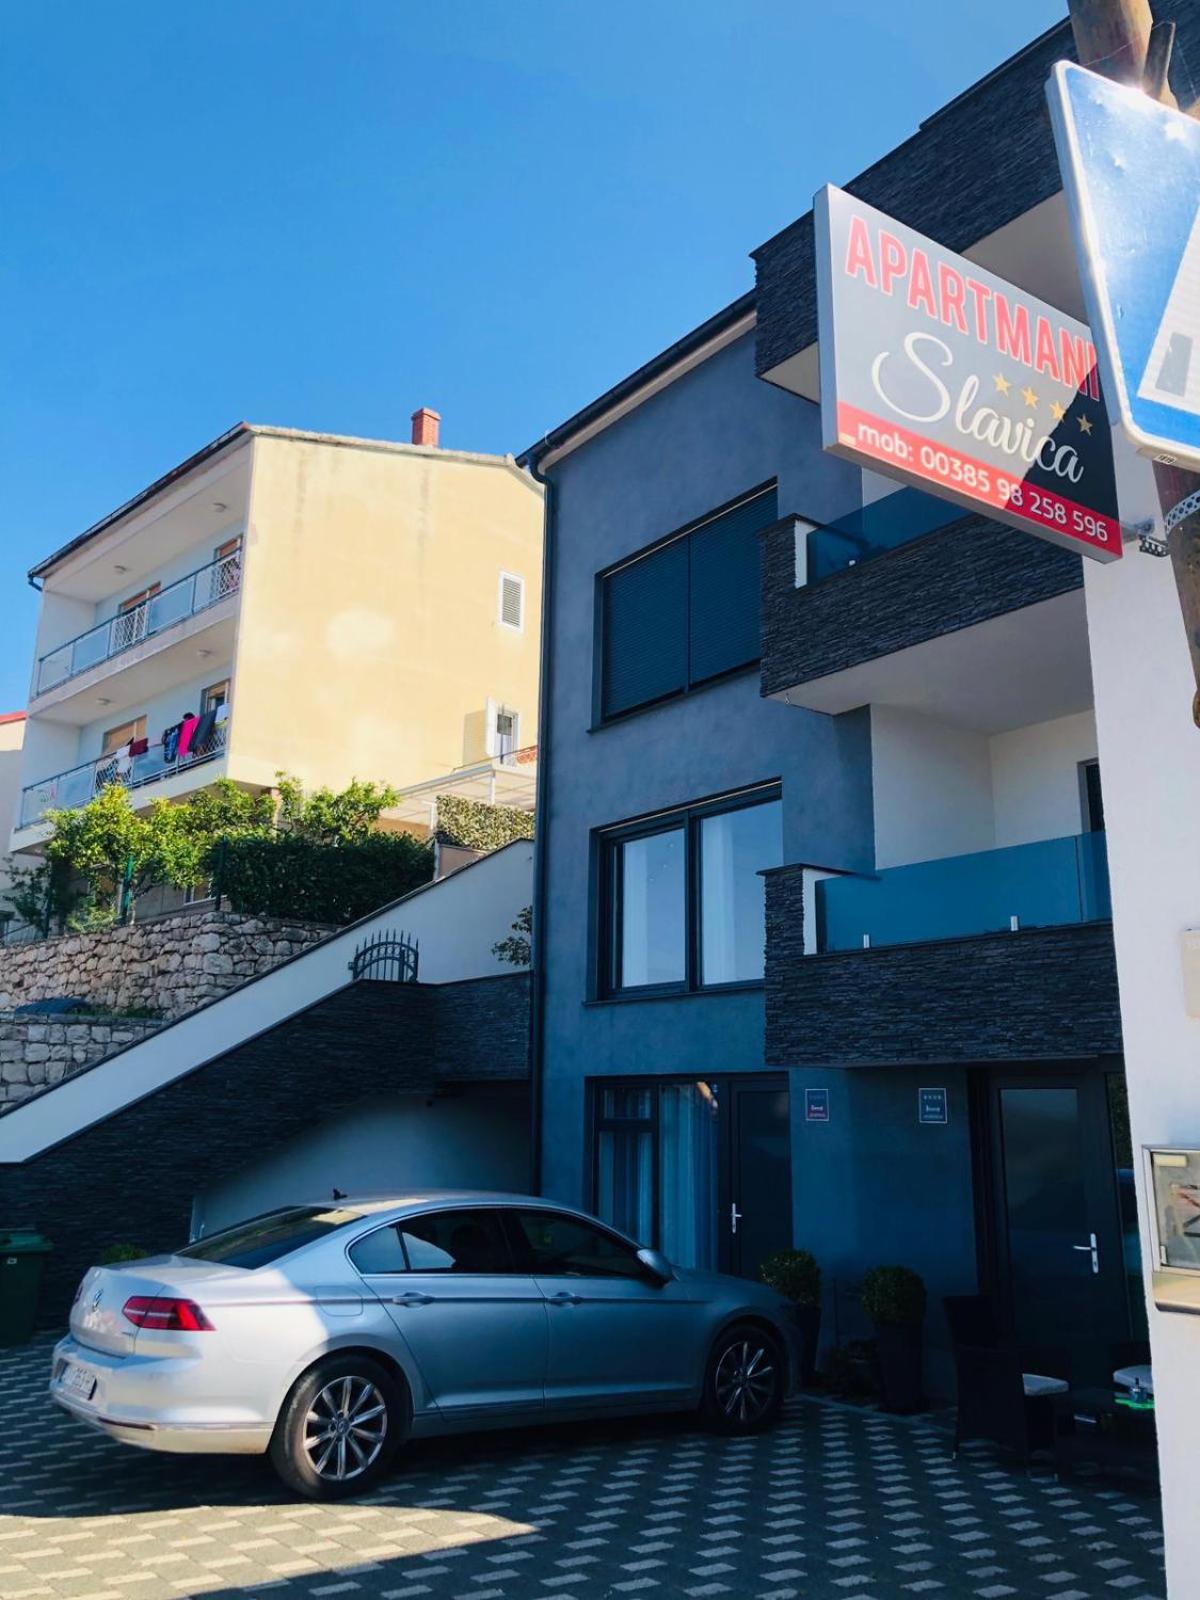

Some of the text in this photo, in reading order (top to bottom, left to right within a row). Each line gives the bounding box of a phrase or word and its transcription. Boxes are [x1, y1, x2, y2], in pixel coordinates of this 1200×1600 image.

[845, 214, 1100, 402] APARTMANI
[857, 421, 1109, 543] mob: 00385 98 258 596
[871, 331, 1085, 484] Slavica
